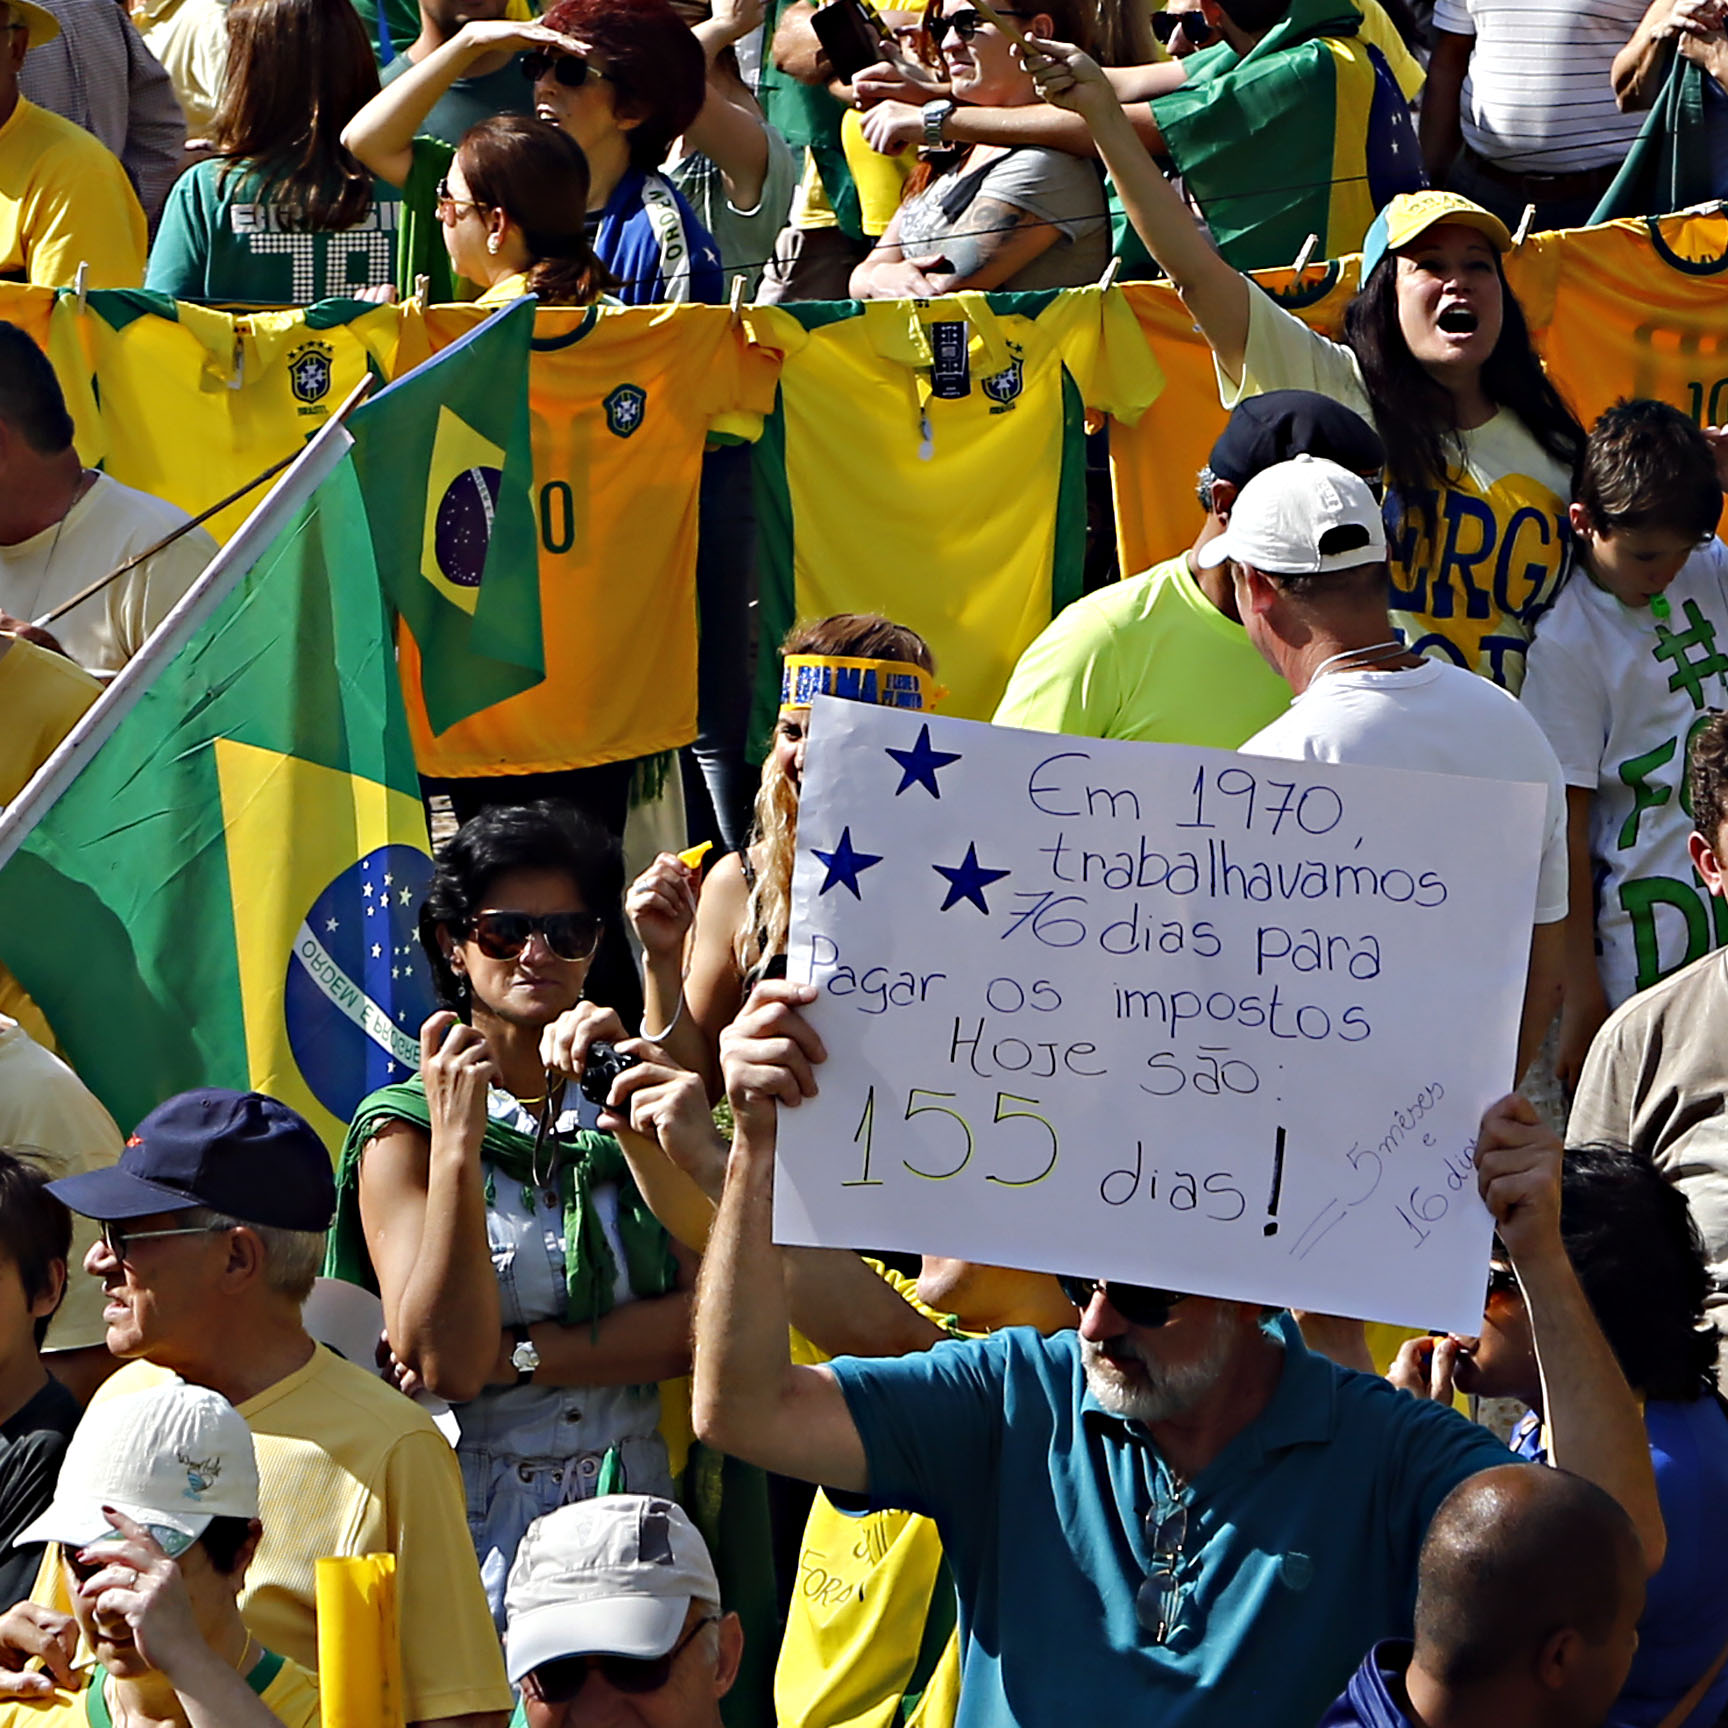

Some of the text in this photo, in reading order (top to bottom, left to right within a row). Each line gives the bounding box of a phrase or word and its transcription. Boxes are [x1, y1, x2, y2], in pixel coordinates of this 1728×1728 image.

[1028, 752, 1141, 820] Em
[1039, 832, 1448, 908] trabalhavamos
[1002, 889, 1382, 981] 76 dias para
[808, 933, 1371, 1043] Pagar os impostos
[841, 1084, 1060, 1189] 155
[1422, 1132, 1437, 1148] e
[1394, 1185, 1449, 1250] 16
